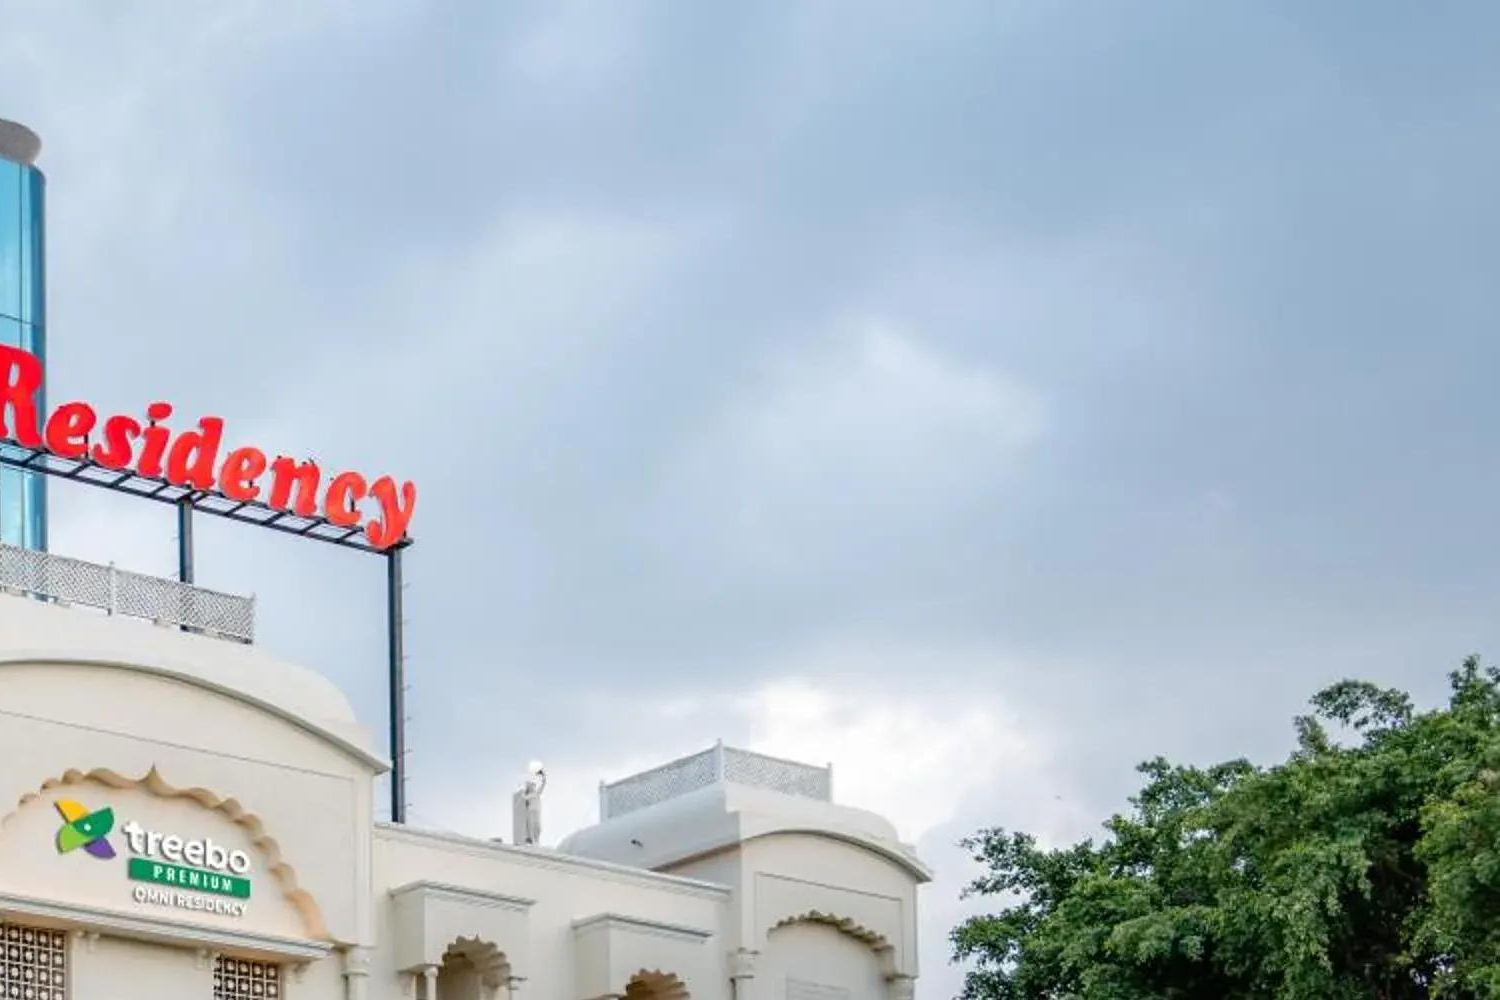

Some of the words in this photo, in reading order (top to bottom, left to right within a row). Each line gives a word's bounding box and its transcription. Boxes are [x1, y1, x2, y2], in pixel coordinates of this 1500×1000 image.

[122, 821, 250, 873] treebo
[153, 866, 233, 891] PREMIUM
[133, 885, 174, 905] OMNI
[176, 893, 248, 916] RESIDENCY
